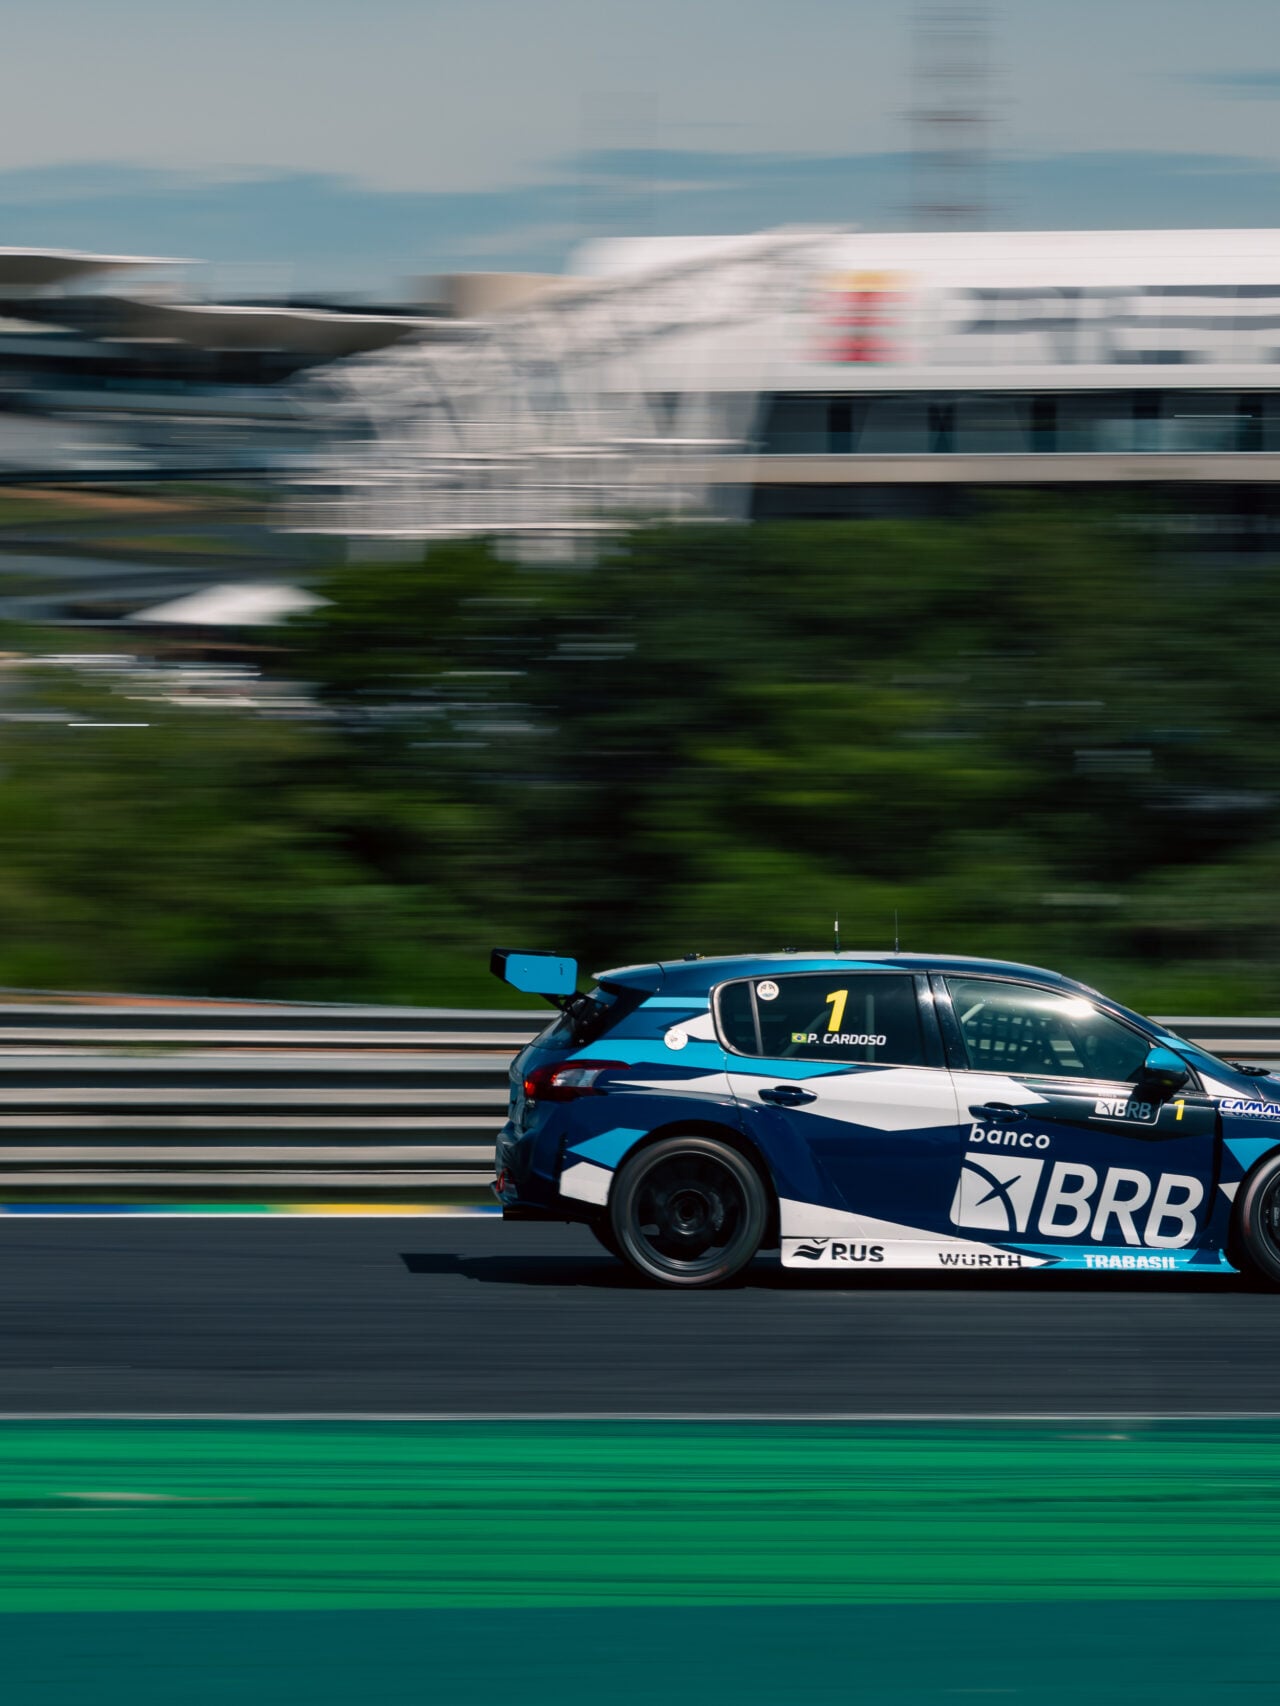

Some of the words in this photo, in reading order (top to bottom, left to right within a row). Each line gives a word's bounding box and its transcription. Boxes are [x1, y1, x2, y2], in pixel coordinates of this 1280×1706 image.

[825, 989, 849, 1032] 1
[807, 1033, 820, 1044] P.
[823, 1033, 887, 1046] CARDOSO
[1114, 1099, 1152, 1120] BRB
[1174, 1099, 1185, 1121] 1
[969, 1123, 1050, 1149] banco
[1038, 1161, 1205, 1249] BRB
[831, 1242, 885, 1263] RUS
[1083, 1254, 1180, 1269] TRABASIL
